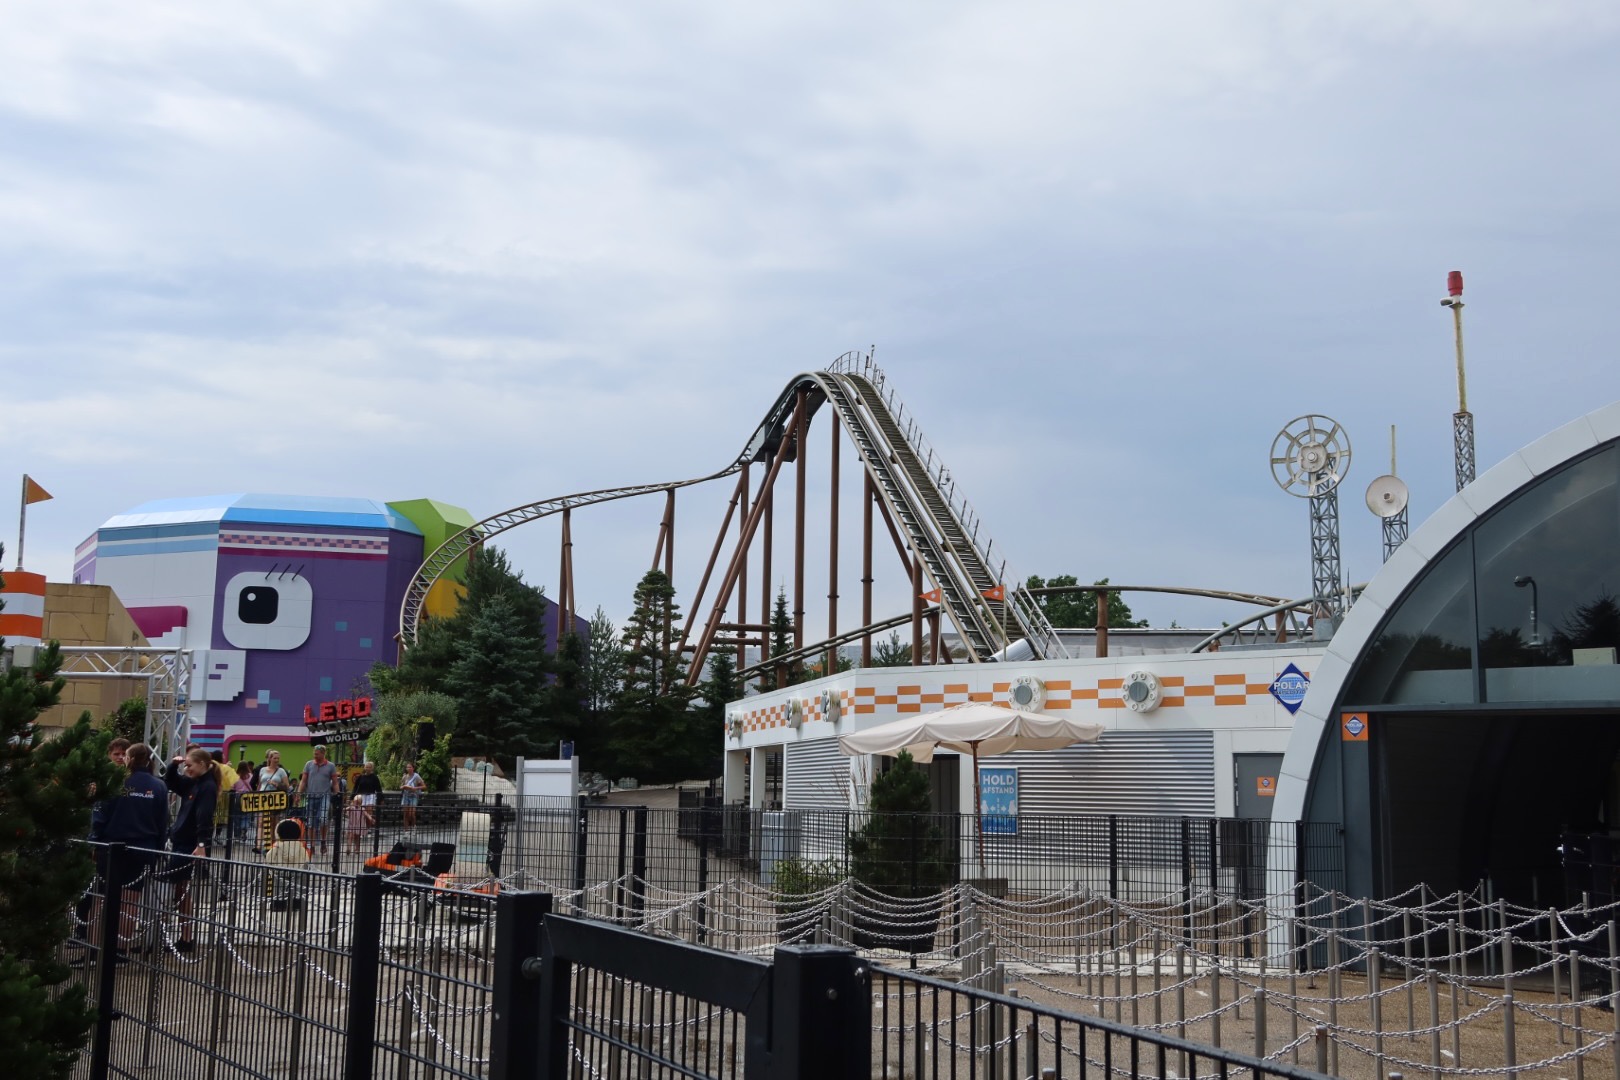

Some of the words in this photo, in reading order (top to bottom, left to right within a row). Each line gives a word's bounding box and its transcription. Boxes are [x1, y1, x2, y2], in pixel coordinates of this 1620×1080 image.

[1273, 681, 1310, 690] POLAR
[303, 697, 371, 723] LEGO
[325, 733, 359, 743] WORLD
[982, 775, 1014, 785] HOLD
[242, 795, 259, 809] THE
[261, 793, 285, 807] POLE
